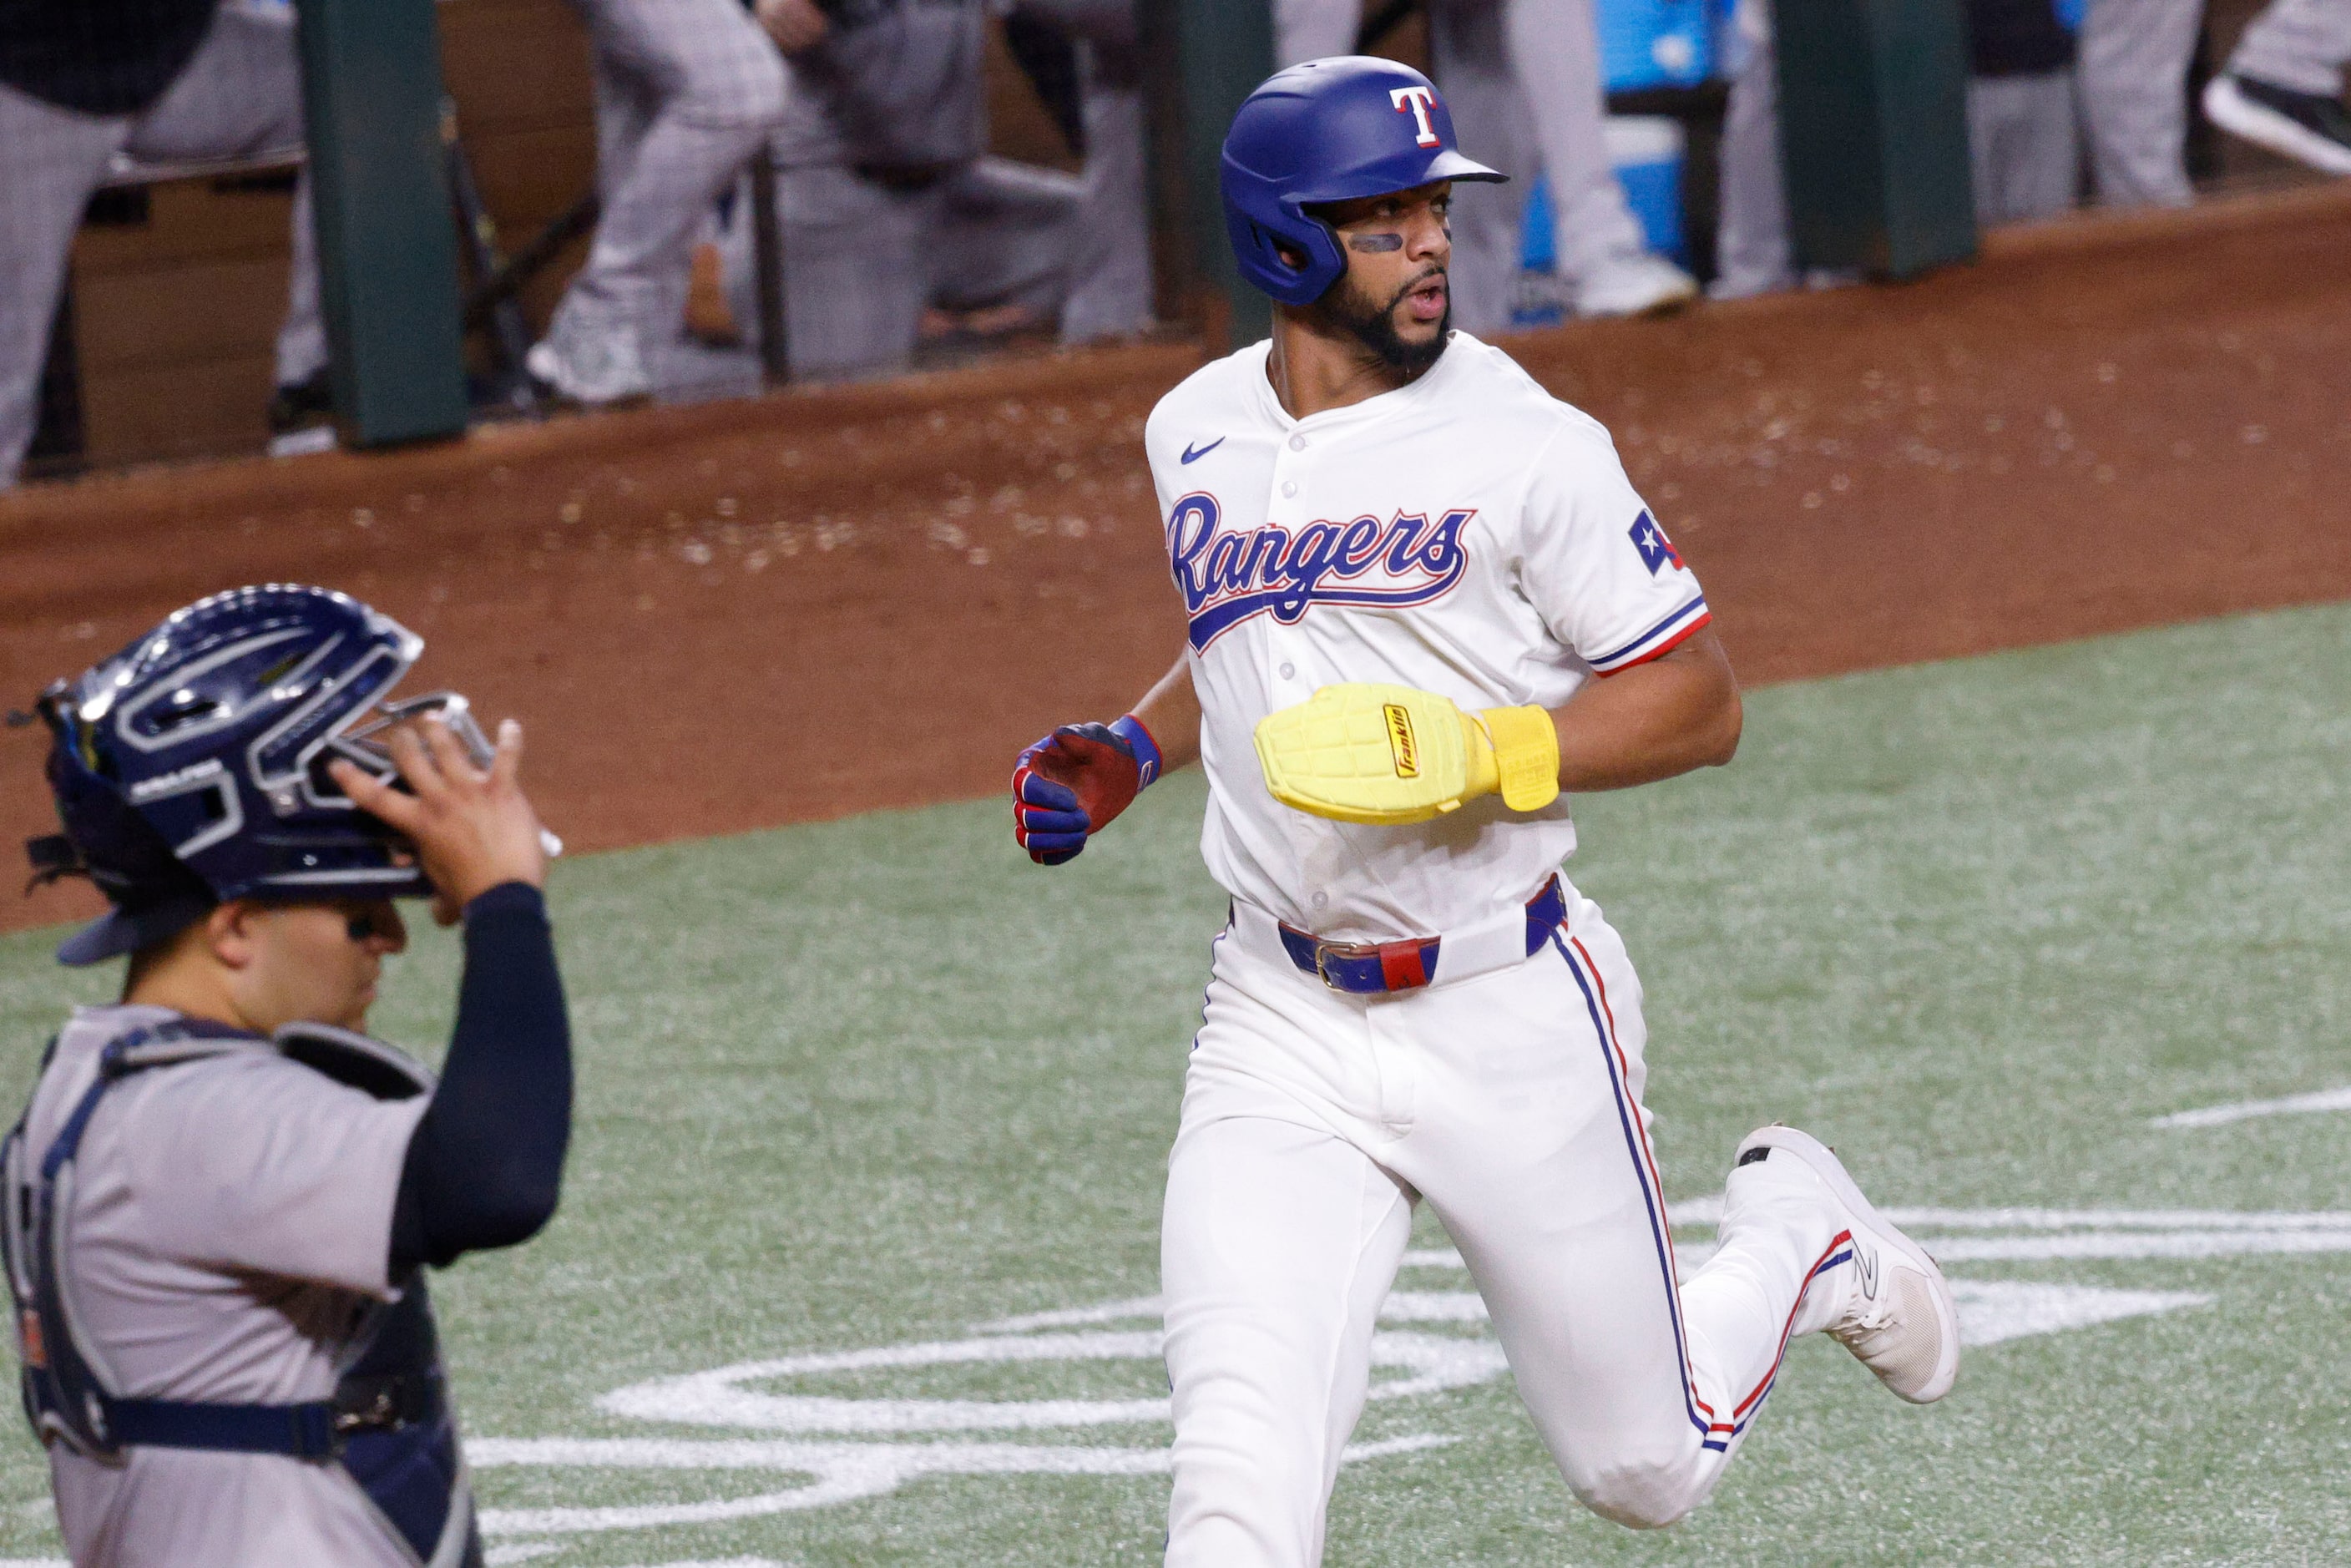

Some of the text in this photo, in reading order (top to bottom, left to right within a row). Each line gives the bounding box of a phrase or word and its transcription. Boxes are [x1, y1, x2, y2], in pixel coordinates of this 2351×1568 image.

[1389, 86, 1441, 149] T
[1167, 491, 1479, 655] Rangers
[1392, 708, 1416, 772] Franklin
